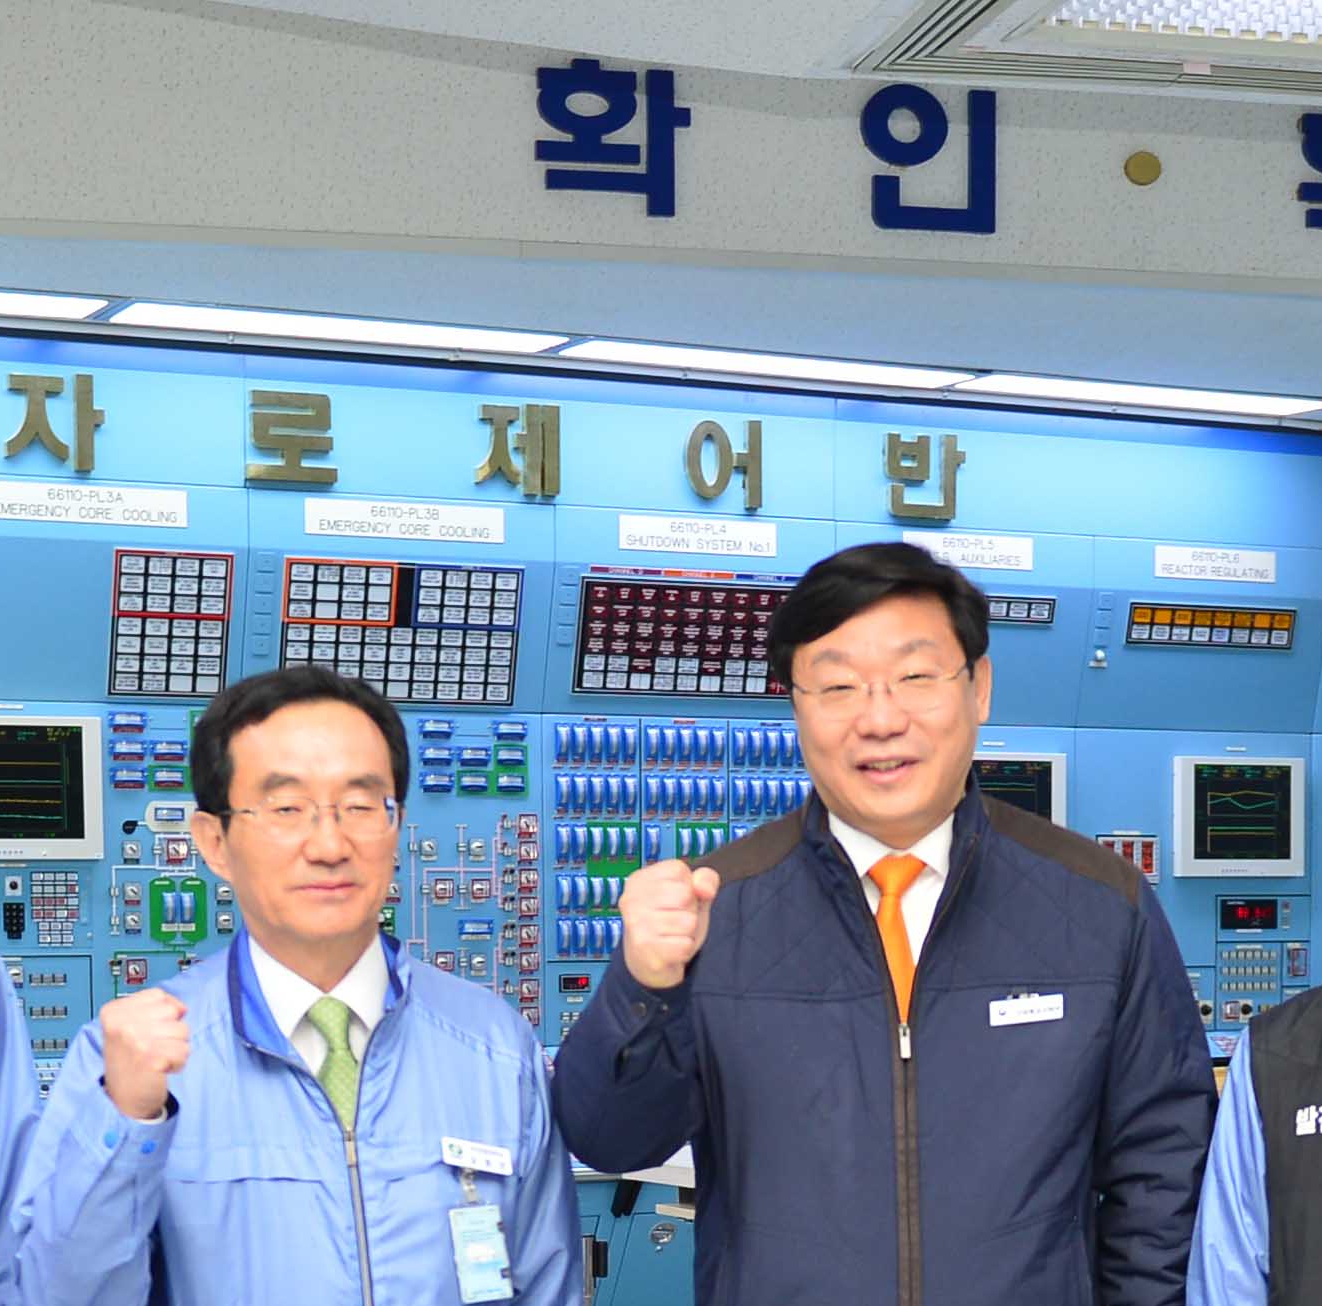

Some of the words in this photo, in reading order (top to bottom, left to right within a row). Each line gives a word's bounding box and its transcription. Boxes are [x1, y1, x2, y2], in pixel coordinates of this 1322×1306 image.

[47, 488, 124, 504] 66110-PL3A
[79, 506, 112, 521] CORE
[122, 508, 178, 523] COOLING
[319, 519, 392, 534] EMERGENCY
[399, 523, 431, 537] CORE
[439, 525, 490, 539] COOLING
[625, 534, 690, 549] SHUTDOWN
[697, 537, 743, 552] SYSTEM
[749, 540, 771, 553] No.1
[960, 553, 1022, 567] AUXILIARIES
[1160, 563, 1208, 576] REACTOR
[1210, 565, 1272, 580] REGULATING
